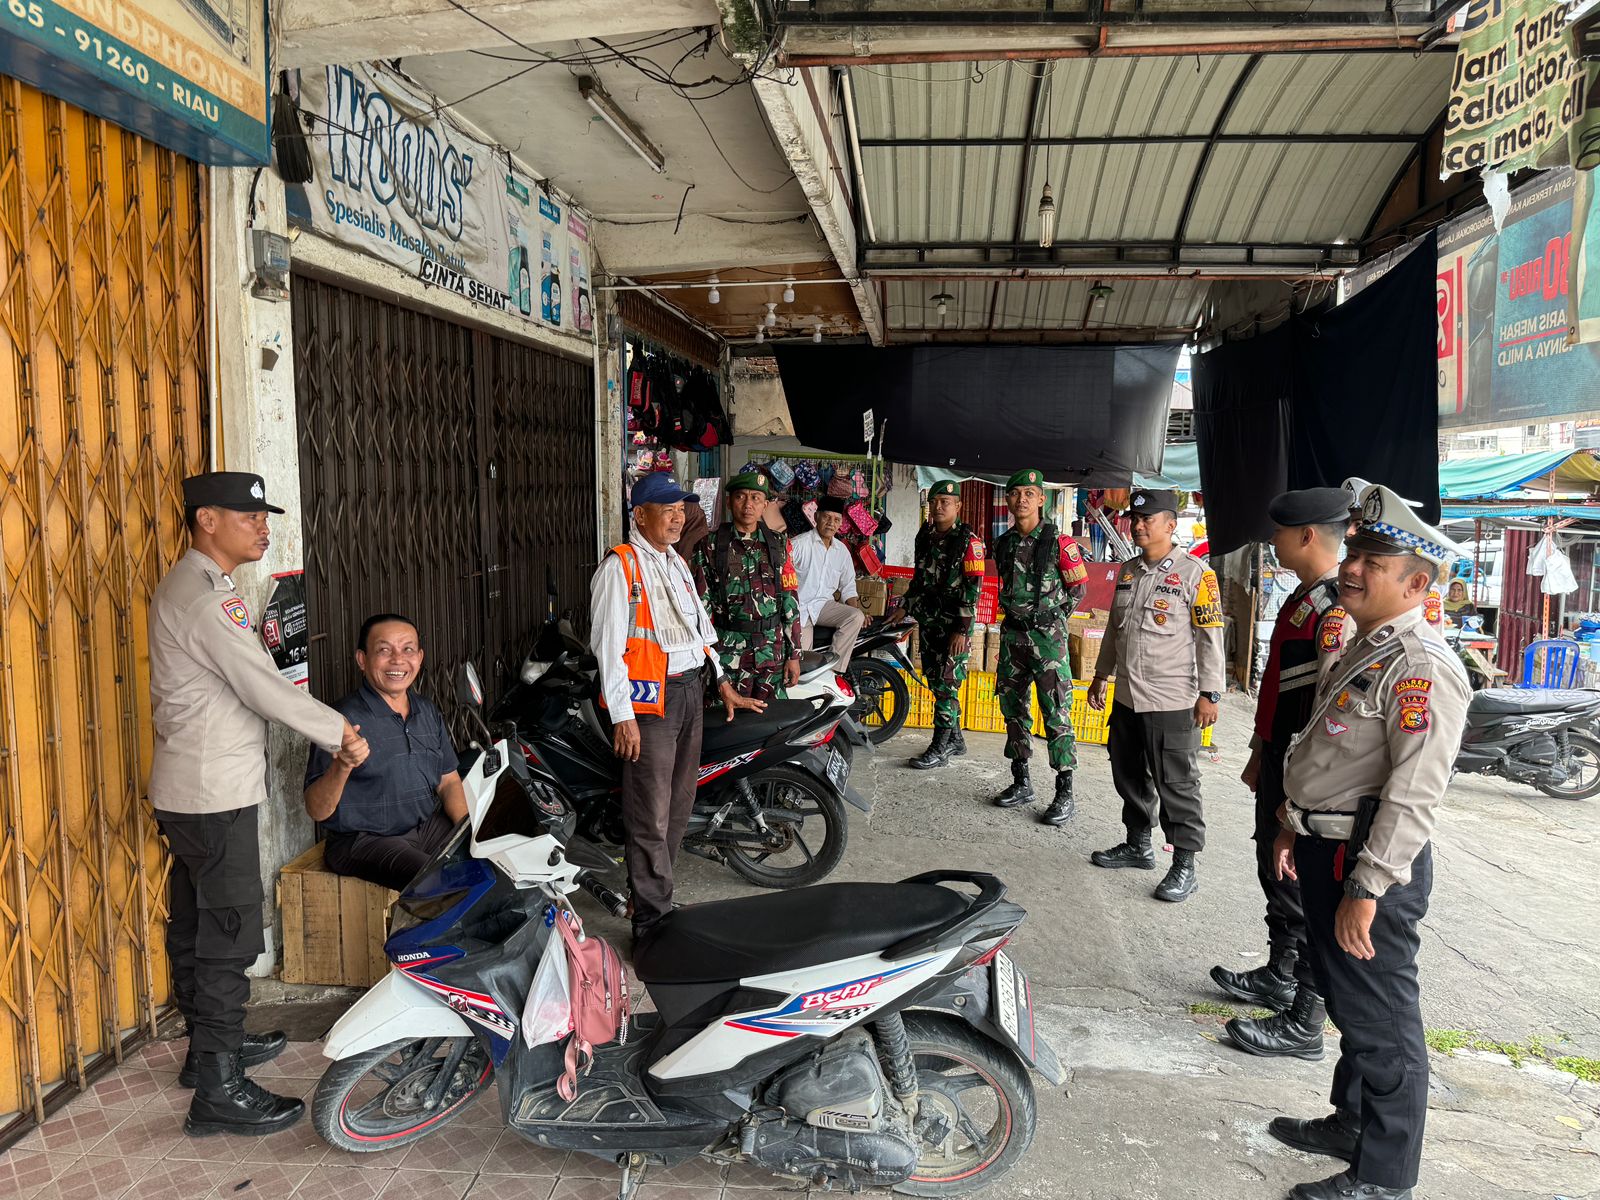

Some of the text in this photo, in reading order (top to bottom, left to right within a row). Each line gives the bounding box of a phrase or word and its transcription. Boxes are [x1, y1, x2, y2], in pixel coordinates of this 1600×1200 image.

[74, 28, 149, 85] 91260
[172, 82, 219, 122] RIAU
[1446, 50, 1573, 130] Calculator,
[1452, 42, 1507, 92] Jam
[1446, 75, 1586, 170] ca maa, dll
[325, 189, 386, 239] Spesialis
[422, 260, 511, 310] CINTA SEHAT
[1155, 585, 1181, 597] POLRI
[1194, 603, 1222, 616] BHA
[1402, 696, 1425, 704] RIAU
[397, 951, 431, 962] HONDA
